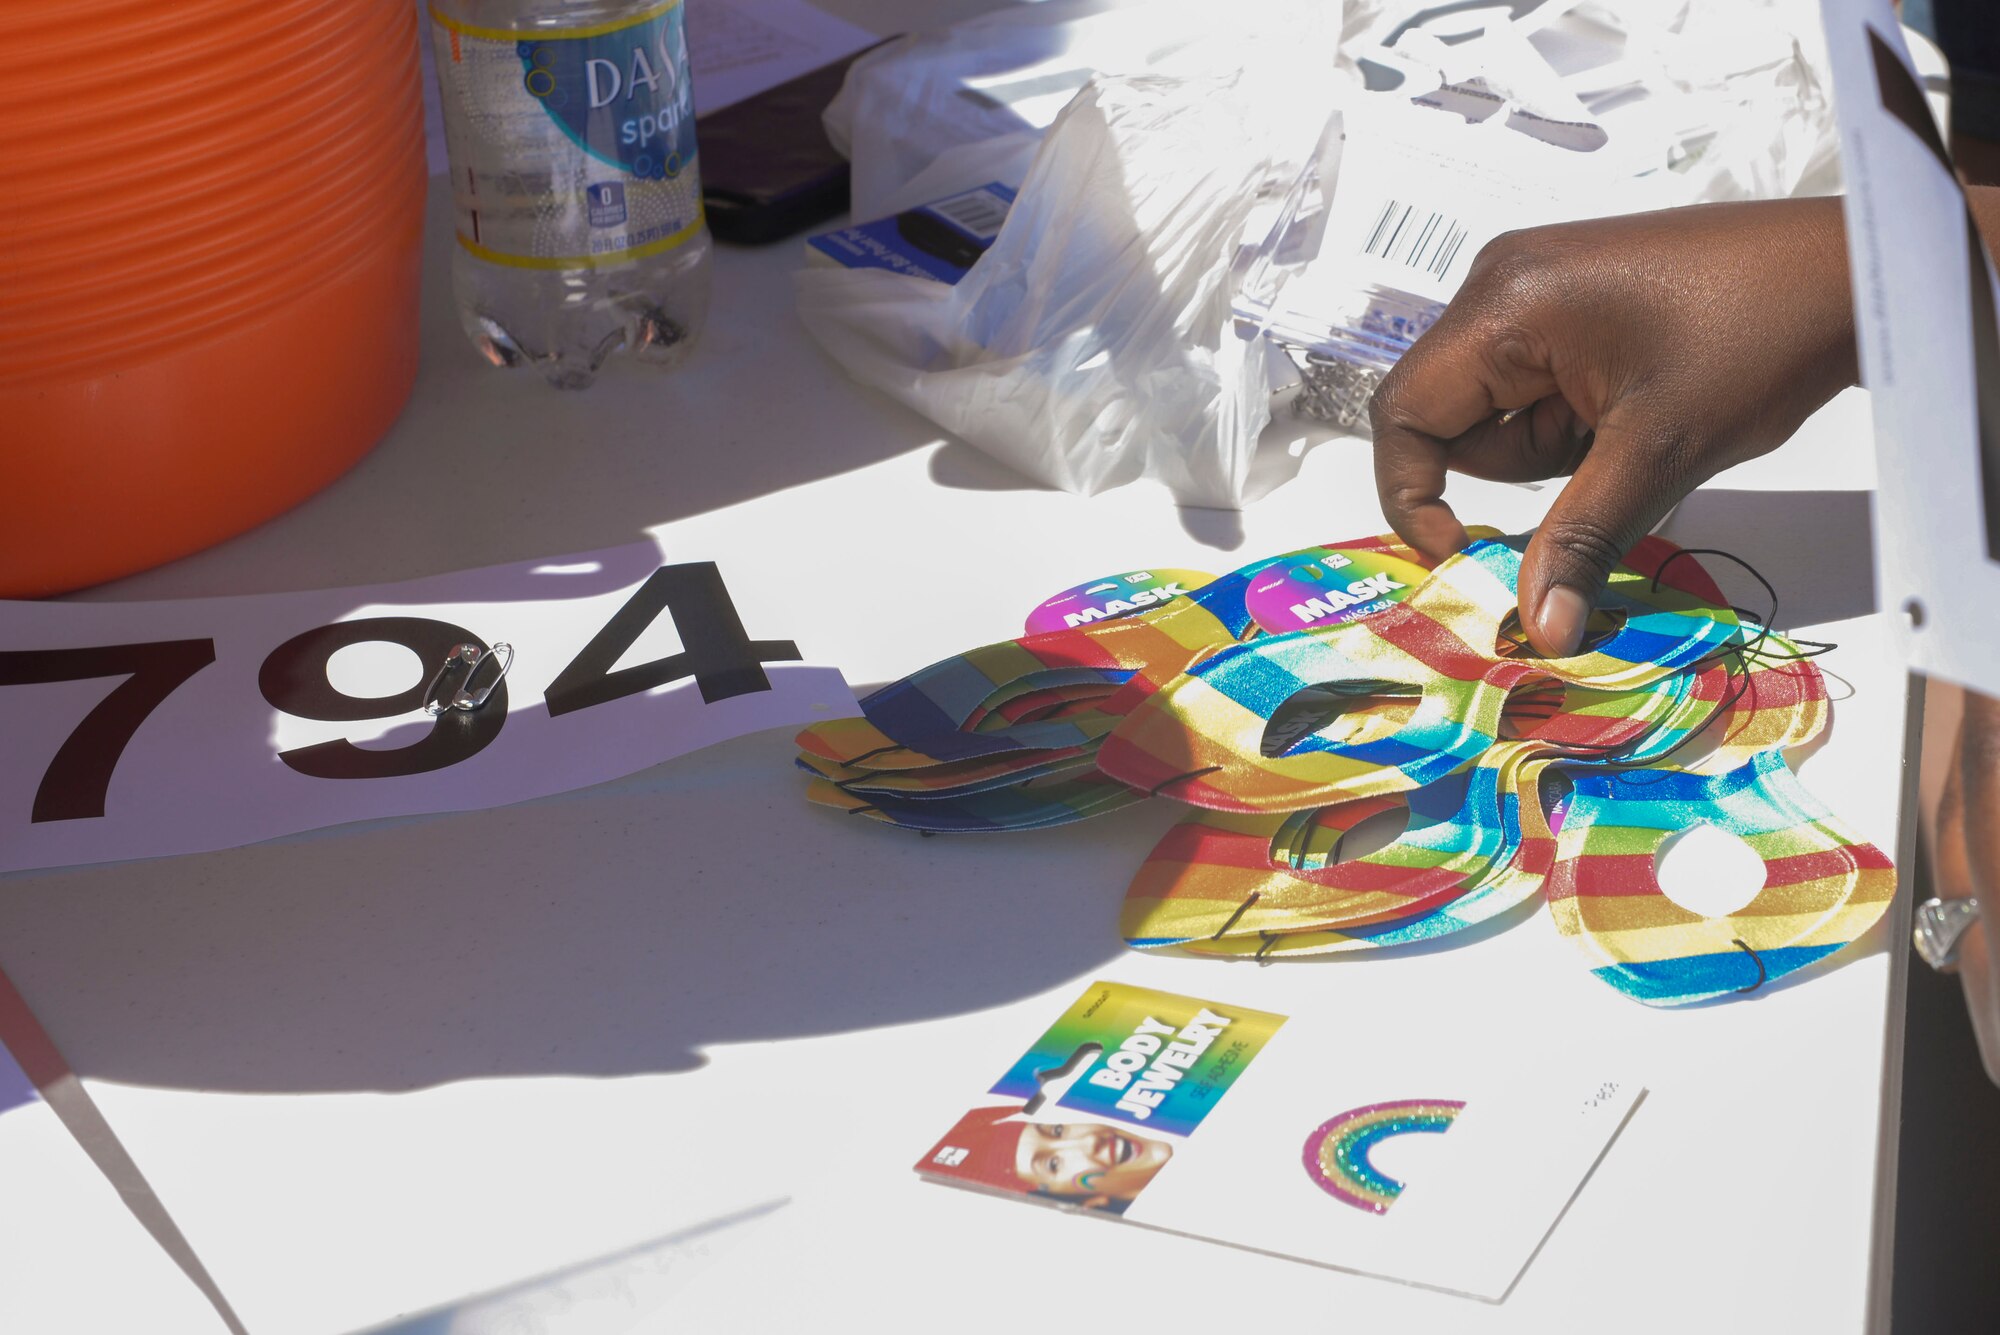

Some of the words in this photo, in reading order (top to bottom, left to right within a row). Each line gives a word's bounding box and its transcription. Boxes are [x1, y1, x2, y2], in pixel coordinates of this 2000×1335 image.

[600, 187, 612, 205] 0
[1062, 581, 1190, 628] MASK
[1289, 571, 1407, 624] MASK
[0, 560, 804, 825] 794
[1089, 1014, 1176, 1091] BODY
[1114, 1006, 1235, 1121] JEWELRY
